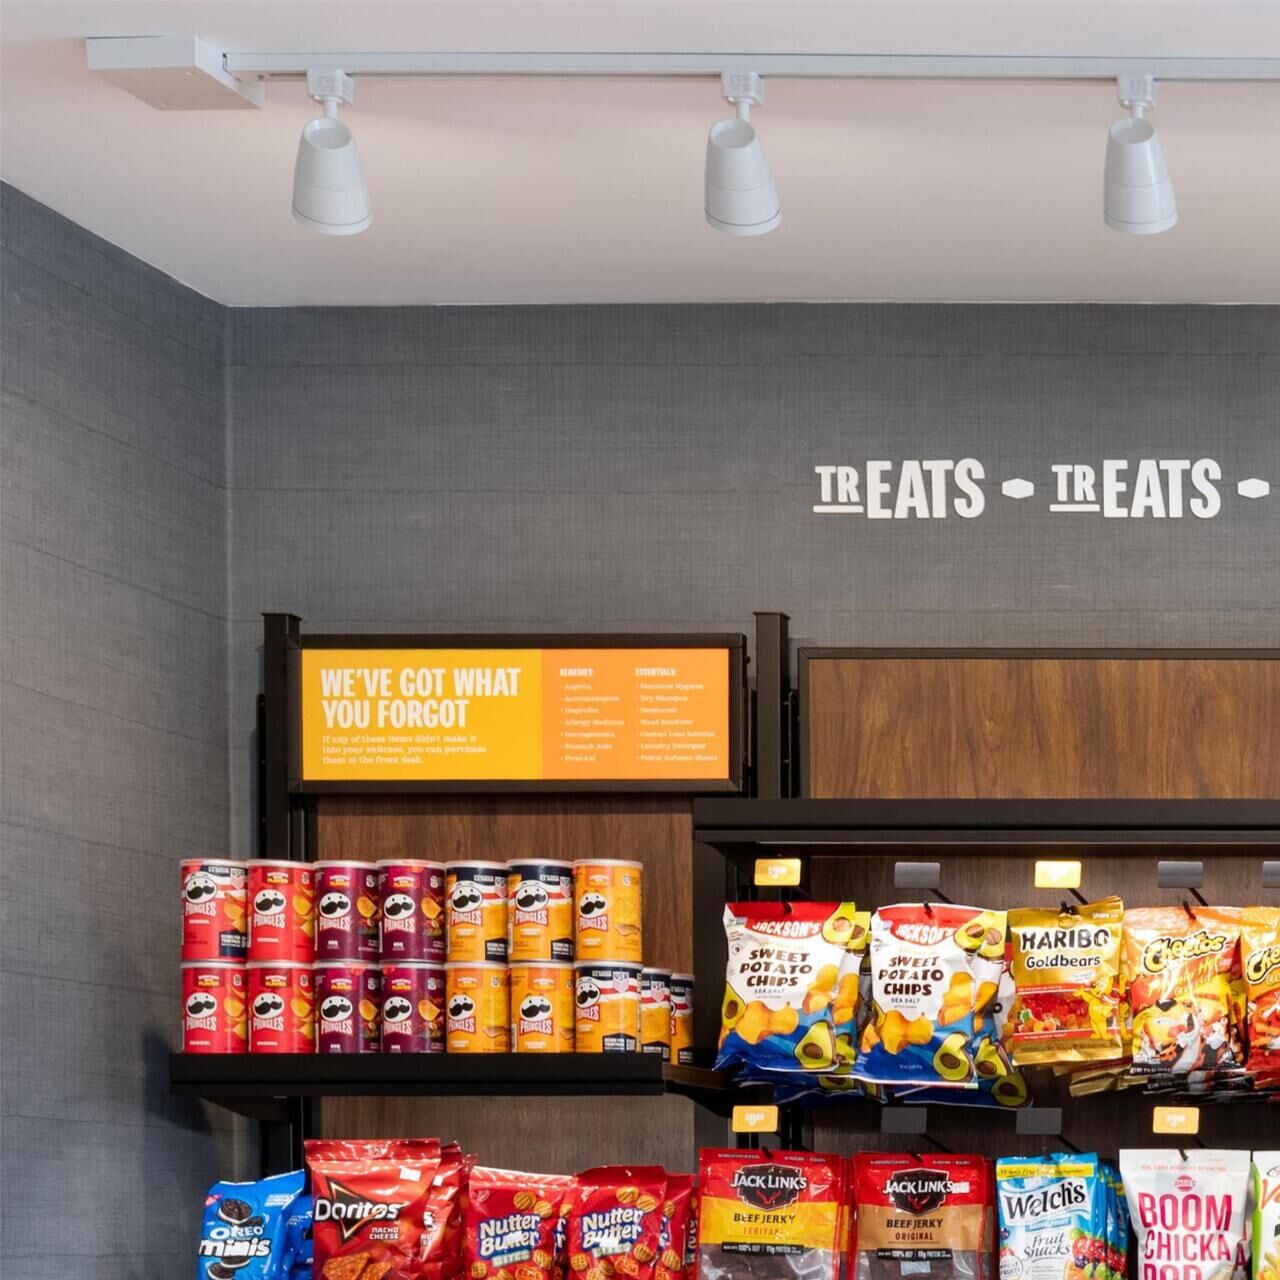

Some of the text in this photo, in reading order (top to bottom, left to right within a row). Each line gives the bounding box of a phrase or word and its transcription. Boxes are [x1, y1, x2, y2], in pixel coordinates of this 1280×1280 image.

[815, 459, 984, 519] TREATS
[1050, 459, 1221, 518] TREATS
[321, 667, 520, 697] WE'VE GOT WHAT
[322, 699, 469, 728] YOU FORGOT
[351, 735, 360, 743] of
[186, 903, 216, 917] PRINGLES
[254, 913, 285, 928] PRINGLES
[752, 921, 821, 937] JACKSON'S
[1022, 929, 1109, 950] HARIBO
[749, 949, 810, 962] SWEET
[1144, 932, 1226, 974] Cheetos
[740, 962, 812, 975] POTATO
[889, 956, 939, 967] SWEET
[1026, 956, 1101, 969] Goldbears
[746, 975, 798, 987] CHIPS
[879, 969, 944, 981] POTATO
[884, 983, 932, 996] CHIPS
[1004, 1181, 1086, 1219] Welch's
[315, 1199, 400, 1221] Doritos
[1138, 1192, 1232, 1232] BOOM
[582, 1208, 644, 1233] Nutter
[733, 1213, 796, 1224] BEEF JERKY
[886, 1219, 943, 1228] BEEF JERKY
[210, 1227, 263, 1240] OREO
[480, 1214, 540, 1240] Nutter
[200, 1238, 271, 1257] minis
[1033, 1232, 1064, 1248] Fruit
[1145, 1230, 1231, 1261] CHICKA
[1024, 1244, 1070, 1259] Snacks
